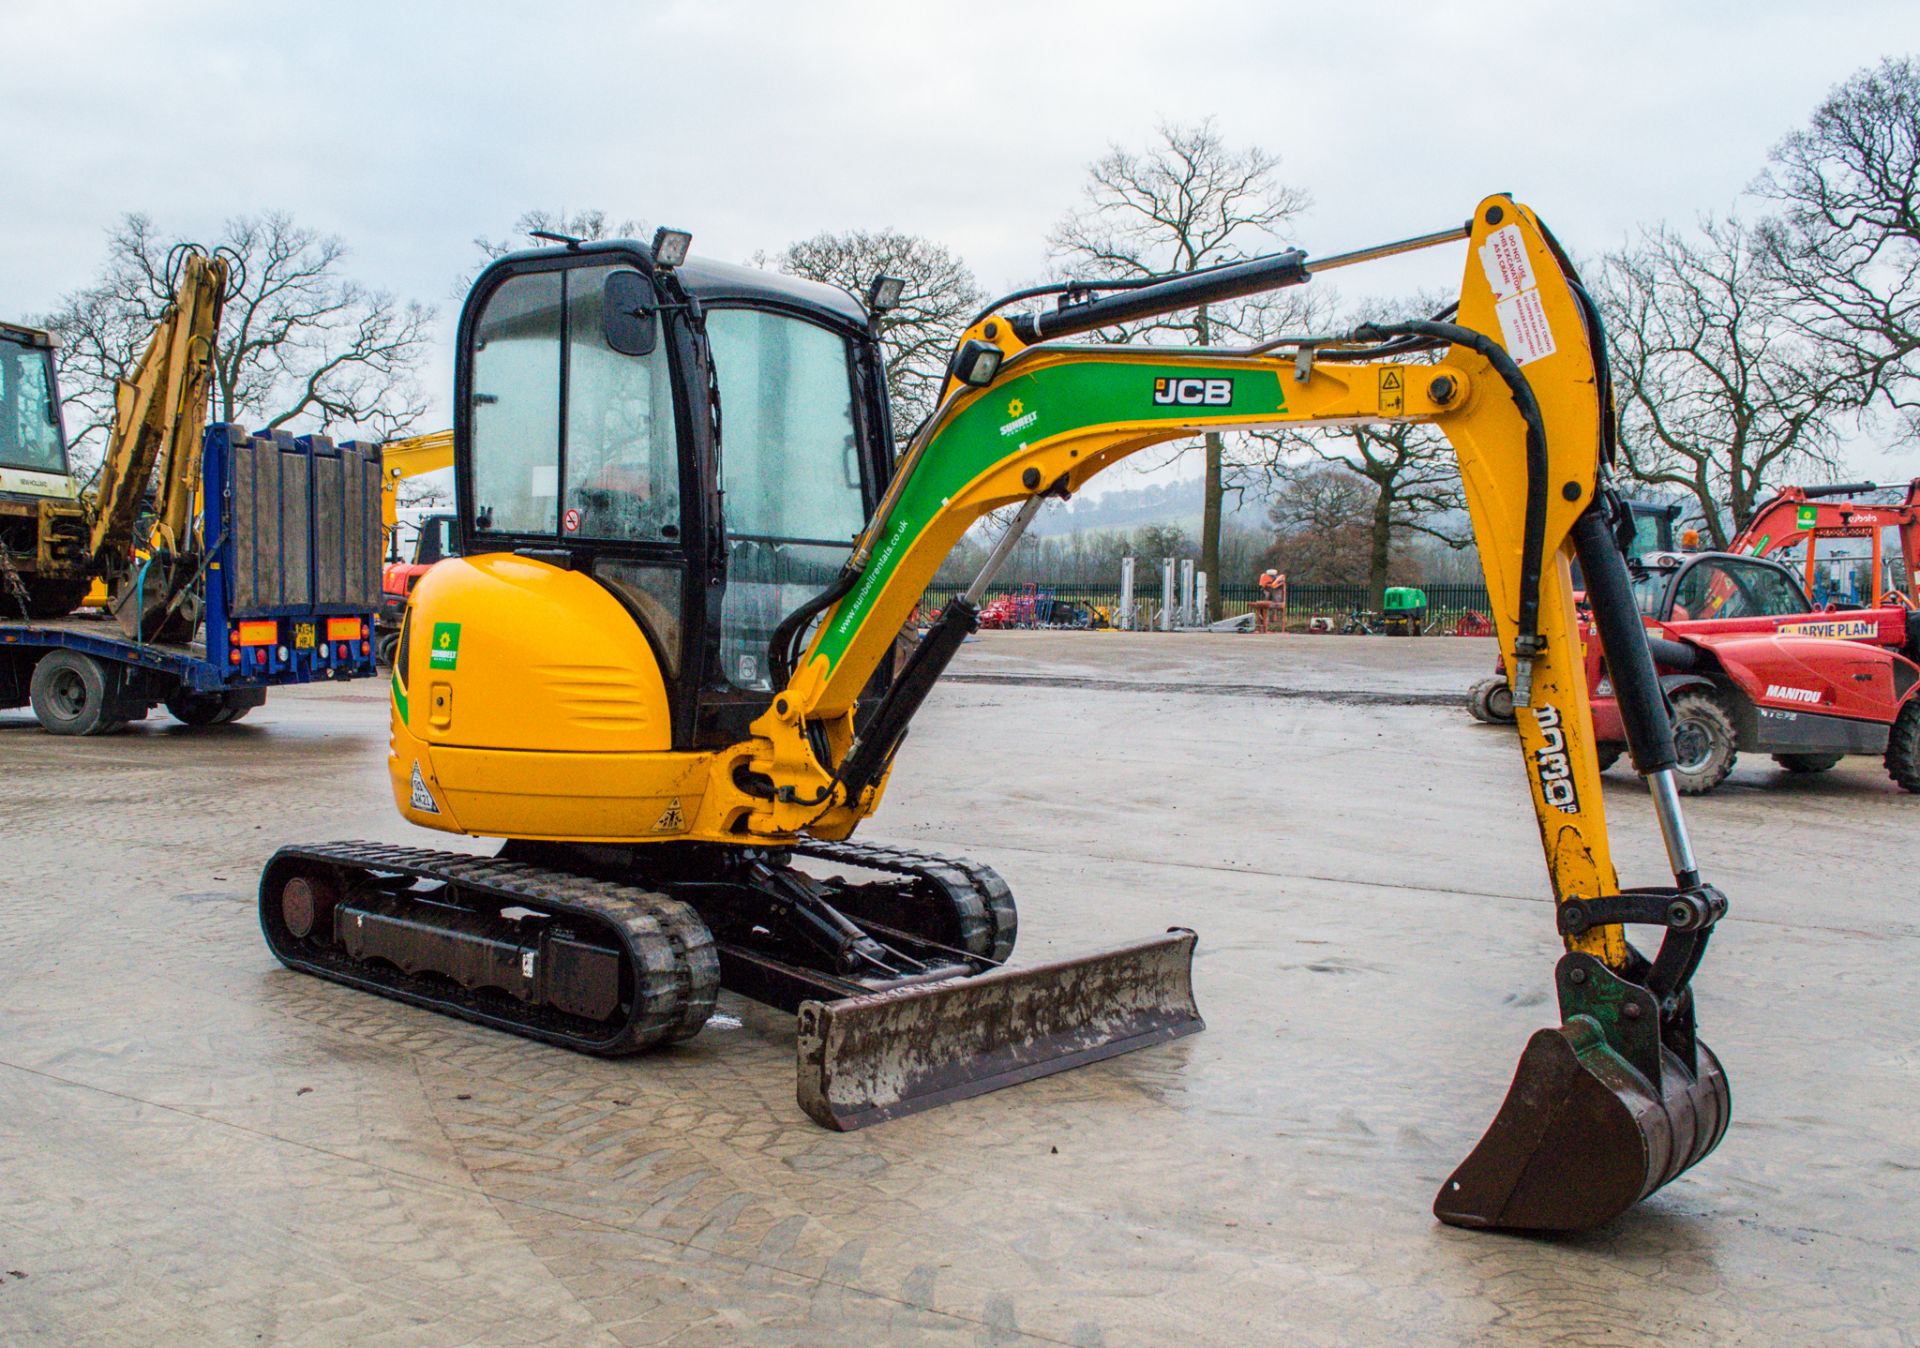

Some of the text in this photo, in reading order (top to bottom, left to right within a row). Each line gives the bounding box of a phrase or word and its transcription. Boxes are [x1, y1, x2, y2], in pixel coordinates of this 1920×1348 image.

[1498, 231, 1507, 248] THIS
[1493, 243, 1501, 254] AS
[1499, 260, 1510, 285] CRANE
[1508, 234, 1527, 279] DO NOT USE
[1155, 379, 1230, 405] JCB
[1001, 410, 1036, 436] SUNBELT
[1848, 514, 1877, 523] ubota
[1766, 684, 1822, 704] MANITOU
